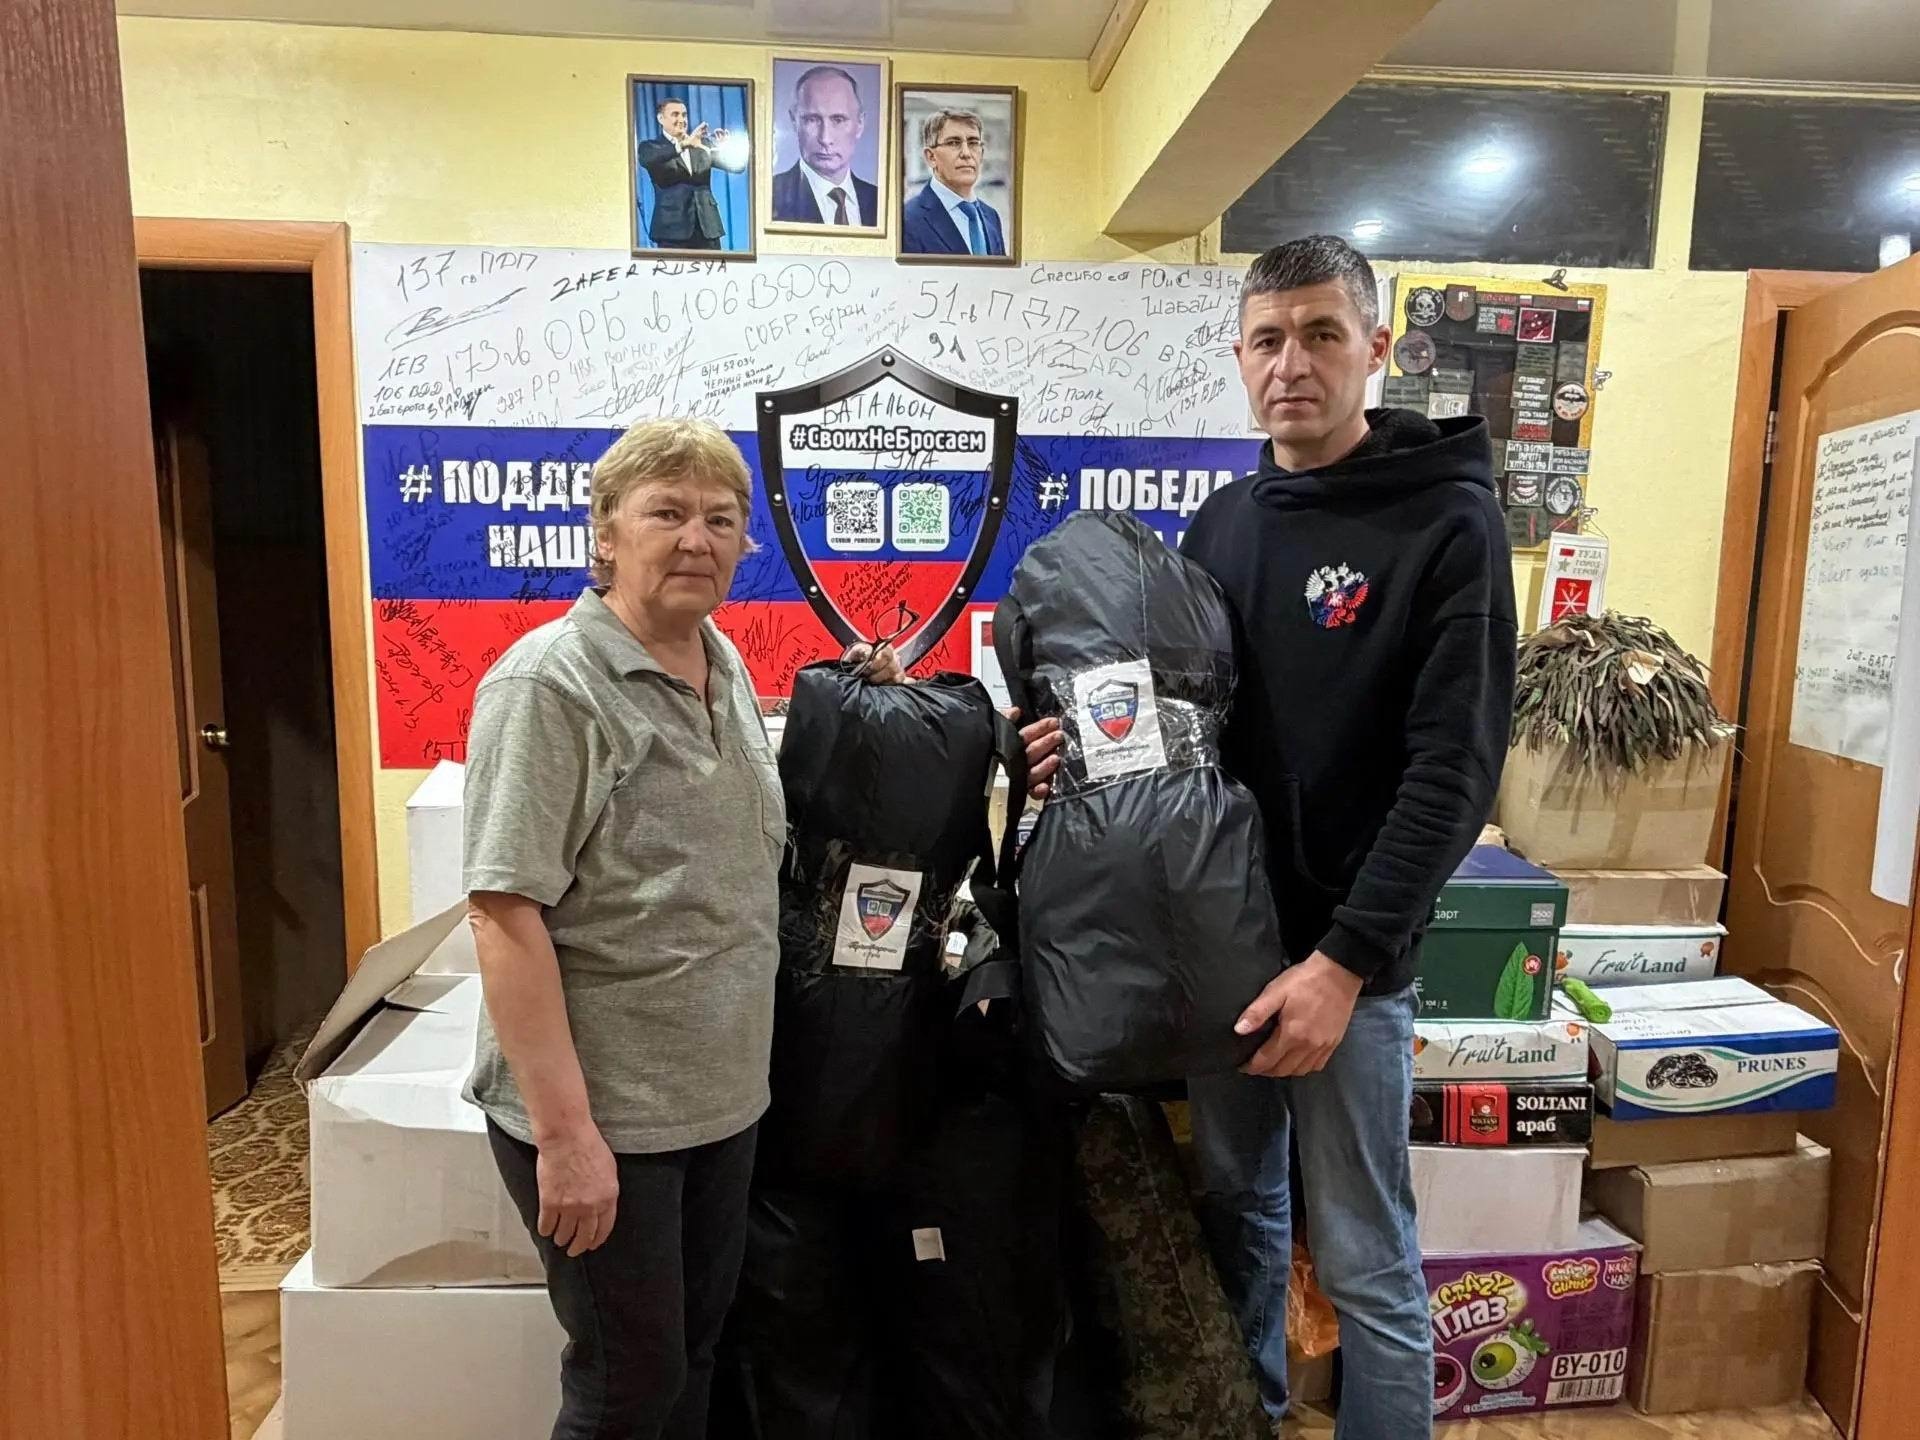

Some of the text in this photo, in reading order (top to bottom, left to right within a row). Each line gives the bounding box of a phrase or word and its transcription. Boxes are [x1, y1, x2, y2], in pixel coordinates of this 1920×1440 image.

[397, 250, 457, 303] 137
[480, 251, 539, 275] ПДП
[652, 257, 728, 276] RUSYA
[1030, 264, 1102, 286] Спасибо
[545, 291, 626, 361] ОРБ
[682, 280, 740, 323] 106
[912, 280, 959, 326] 51
[1092, 316, 1150, 356] 106
[928, 332, 966, 363] 91
[374, 384, 404, 403] 106
[822, 391, 937, 426] БАТАЛЬОН
[790, 424, 986, 452] #СвоихНеБросаем
[442, 459, 597, 512] ПОДДЕ
[1588, 949, 1687, 975] Fruit Land
[1448, 1034, 1557, 1067] Fruit Land
[1736, 1056, 1807, 1075] PRUNES
[1516, 1096, 1588, 1111] SOLTANI
[1516, 1115, 1557, 1136] араб
[1439, 1272, 1515, 1305] CRAZY
[1433, 1296, 1508, 1341] Глаз
[1553, 1352, 1625, 1378] BY-010
